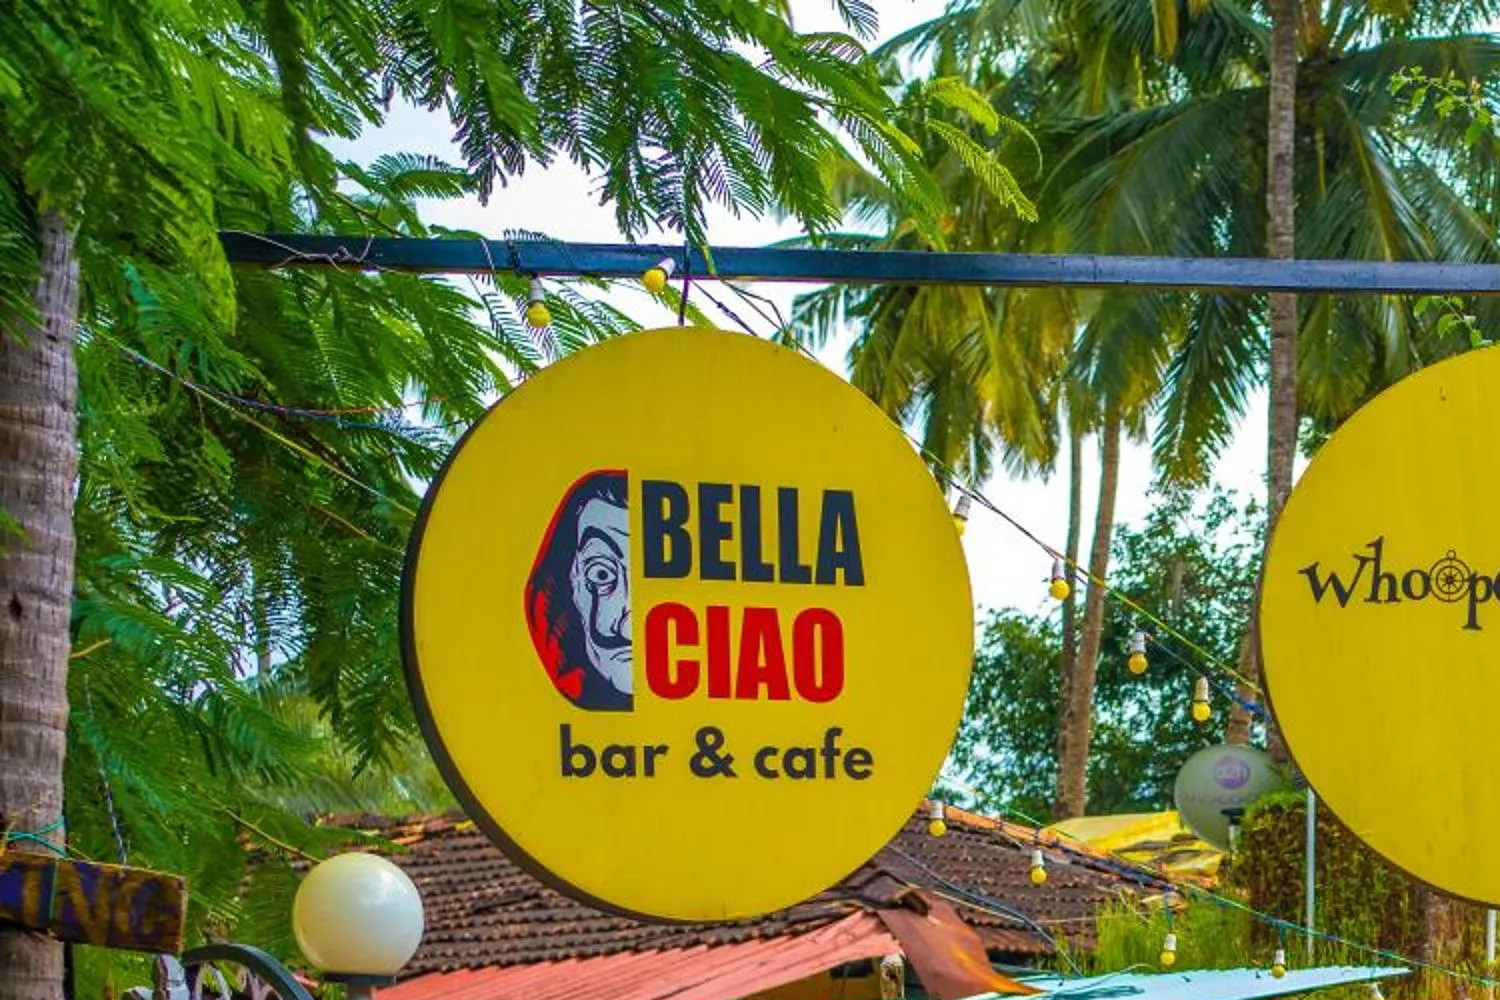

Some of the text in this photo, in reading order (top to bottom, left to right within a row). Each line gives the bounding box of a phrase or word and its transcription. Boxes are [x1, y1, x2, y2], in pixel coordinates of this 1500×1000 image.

[642, 479, 865, 587] BELLA
[644, 601, 845, 704] CIAO
[559, 723, 875, 781] bar & cafe
